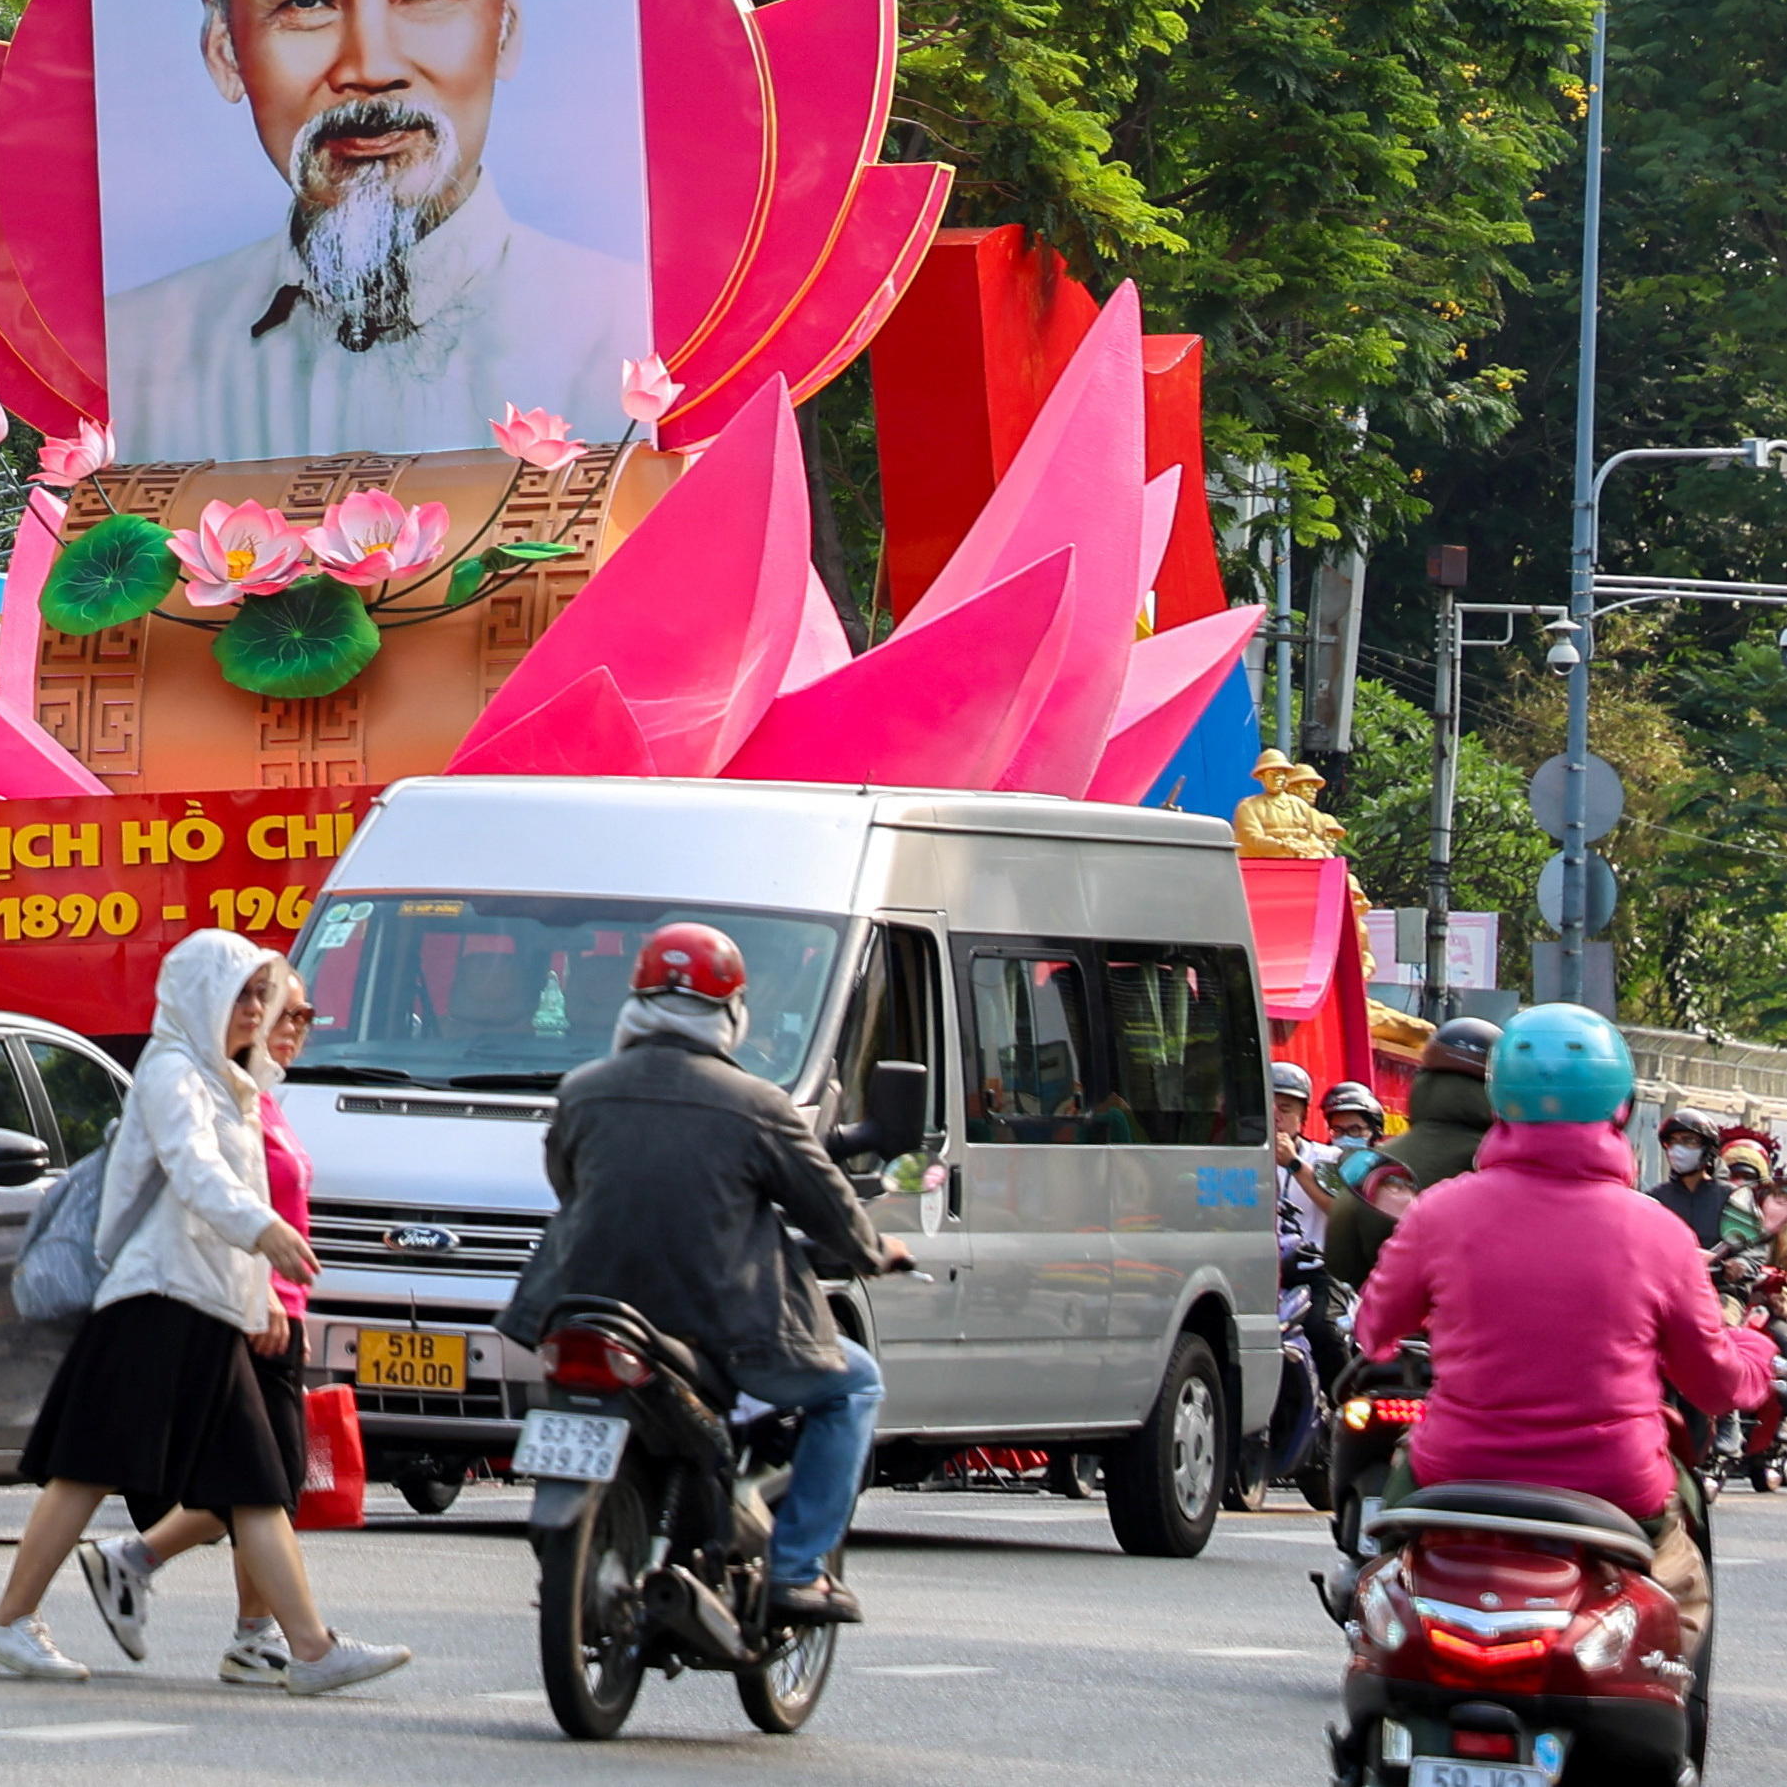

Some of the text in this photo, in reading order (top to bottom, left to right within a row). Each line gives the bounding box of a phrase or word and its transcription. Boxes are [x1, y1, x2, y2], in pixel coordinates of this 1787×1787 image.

[121, 799, 225, 866] HỒ
[247, 801, 354, 861] CHÍ
[398, 1228, 441, 1247] Ford
[388, 1334, 435, 1359] 51B
[372, 1359, 453, 1387] 140.00
